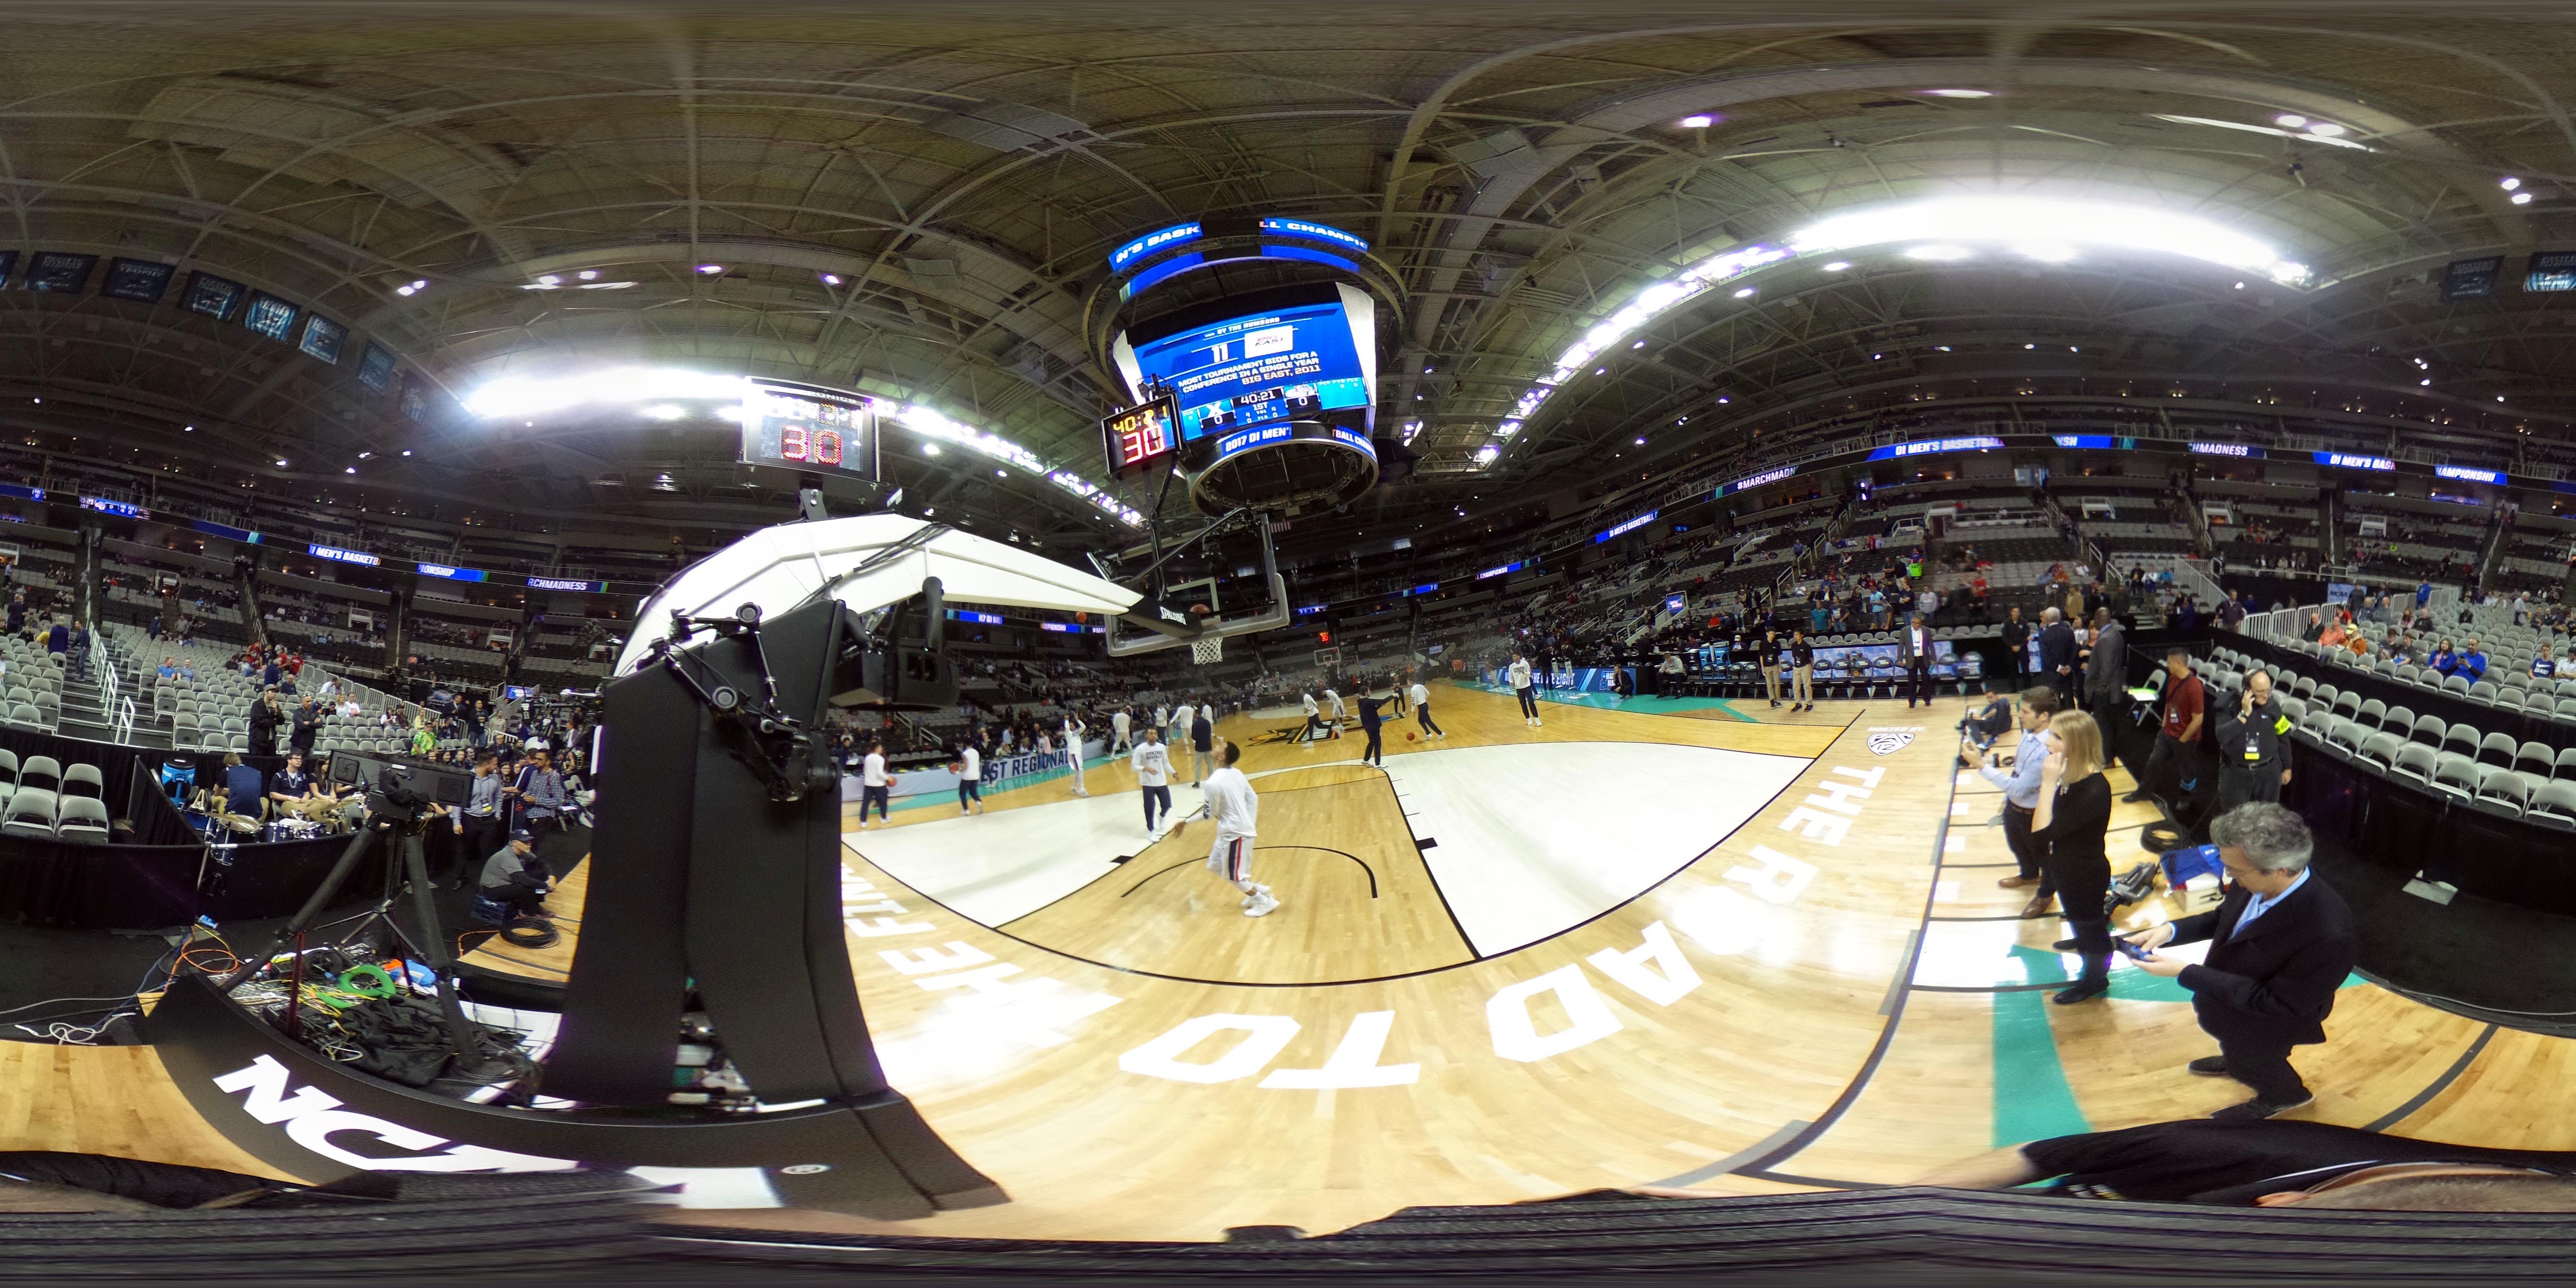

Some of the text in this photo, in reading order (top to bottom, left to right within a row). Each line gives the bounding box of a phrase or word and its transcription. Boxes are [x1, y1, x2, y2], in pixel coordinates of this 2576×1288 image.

[1229, 324, 1242, 332] THE
[1211, 343, 1229, 363] 11
[1178, 375, 1203, 388] MOST
[1203, 359, 1264, 380] TOURNAMENT
[1265, 355, 1289, 365] BIDS
[1290, 352, 1309, 360] FOR
[1183, 374, 1238, 393] CONFERENCE
[1240, 370, 1251, 378] IN
[1259, 361, 1294, 373] SINGLE
[1293, 358, 1319, 367] YEAR
[1242, 364, 1322, 385] BIG EAST, 2011
[1241, 391, 1276, 404] 40:21
[1252, 402, 1268, 411] 1ST
[1298, 396, 1308, 406] 0
[1112, 405, 1168, 434] 40:21
[1214, 414, 1223, 425] 0
[781, 425, 842, 465] 30
[1122, 424, 1165, 463] 30
[1225, 435, 1247, 452] 2017
[1249, 432, 1260, 443] DI
[1895, 445, 1907, 455] DI
[1908, 441, 1940, 453] MEN'S
[2329, 454, 2342, 465] DI
[2341, 456, 2372, 468] MEN'S
[1614, 524, 1627, 535] MEN'S
[1627, 513, 1655, 530] BASKETBALL
[316, 547, 343, 559] MEN'S
[1160, 606, 1187, 626] SPALDING
[1778, 766, 1886, 847] THE
[1118, 1010, 1421, 1090] TO
